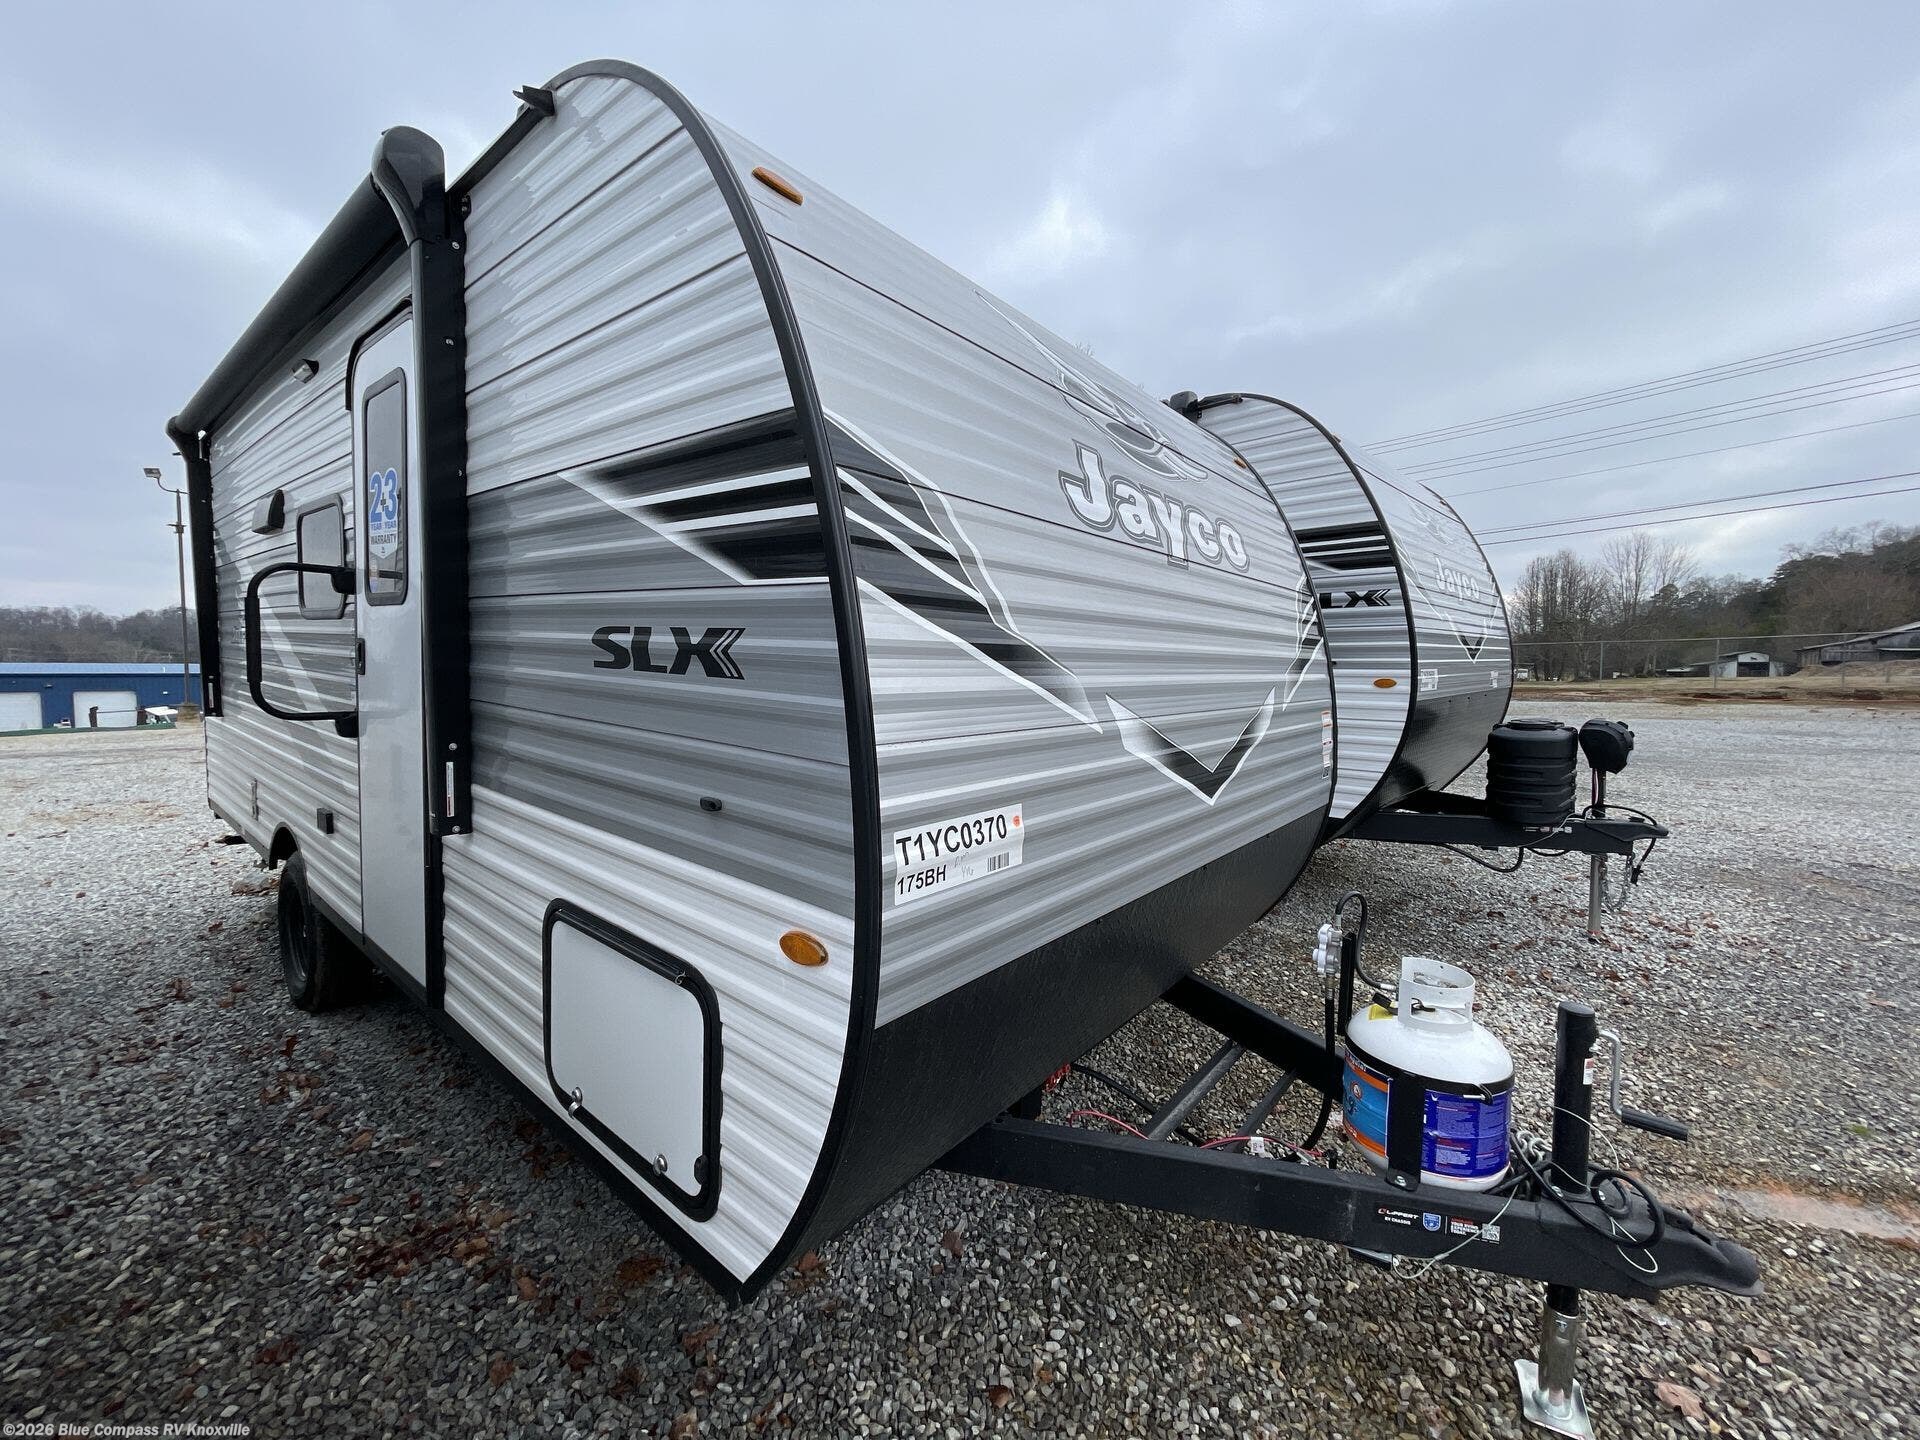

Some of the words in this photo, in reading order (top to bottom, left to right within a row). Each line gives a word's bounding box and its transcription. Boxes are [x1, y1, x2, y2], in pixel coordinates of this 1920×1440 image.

[1058, 439, 1250, 572] Jayco
[370, 534, 396, 545] WARRANTY
[1319, 589, 1391, 608] LX
[1434, 555, 1480, 603] Jayco
[592, 626, 746, 680] SLX
[896, 814, 1007, 866] T1YC0370
[897, 864, 947, 895] 175BH
